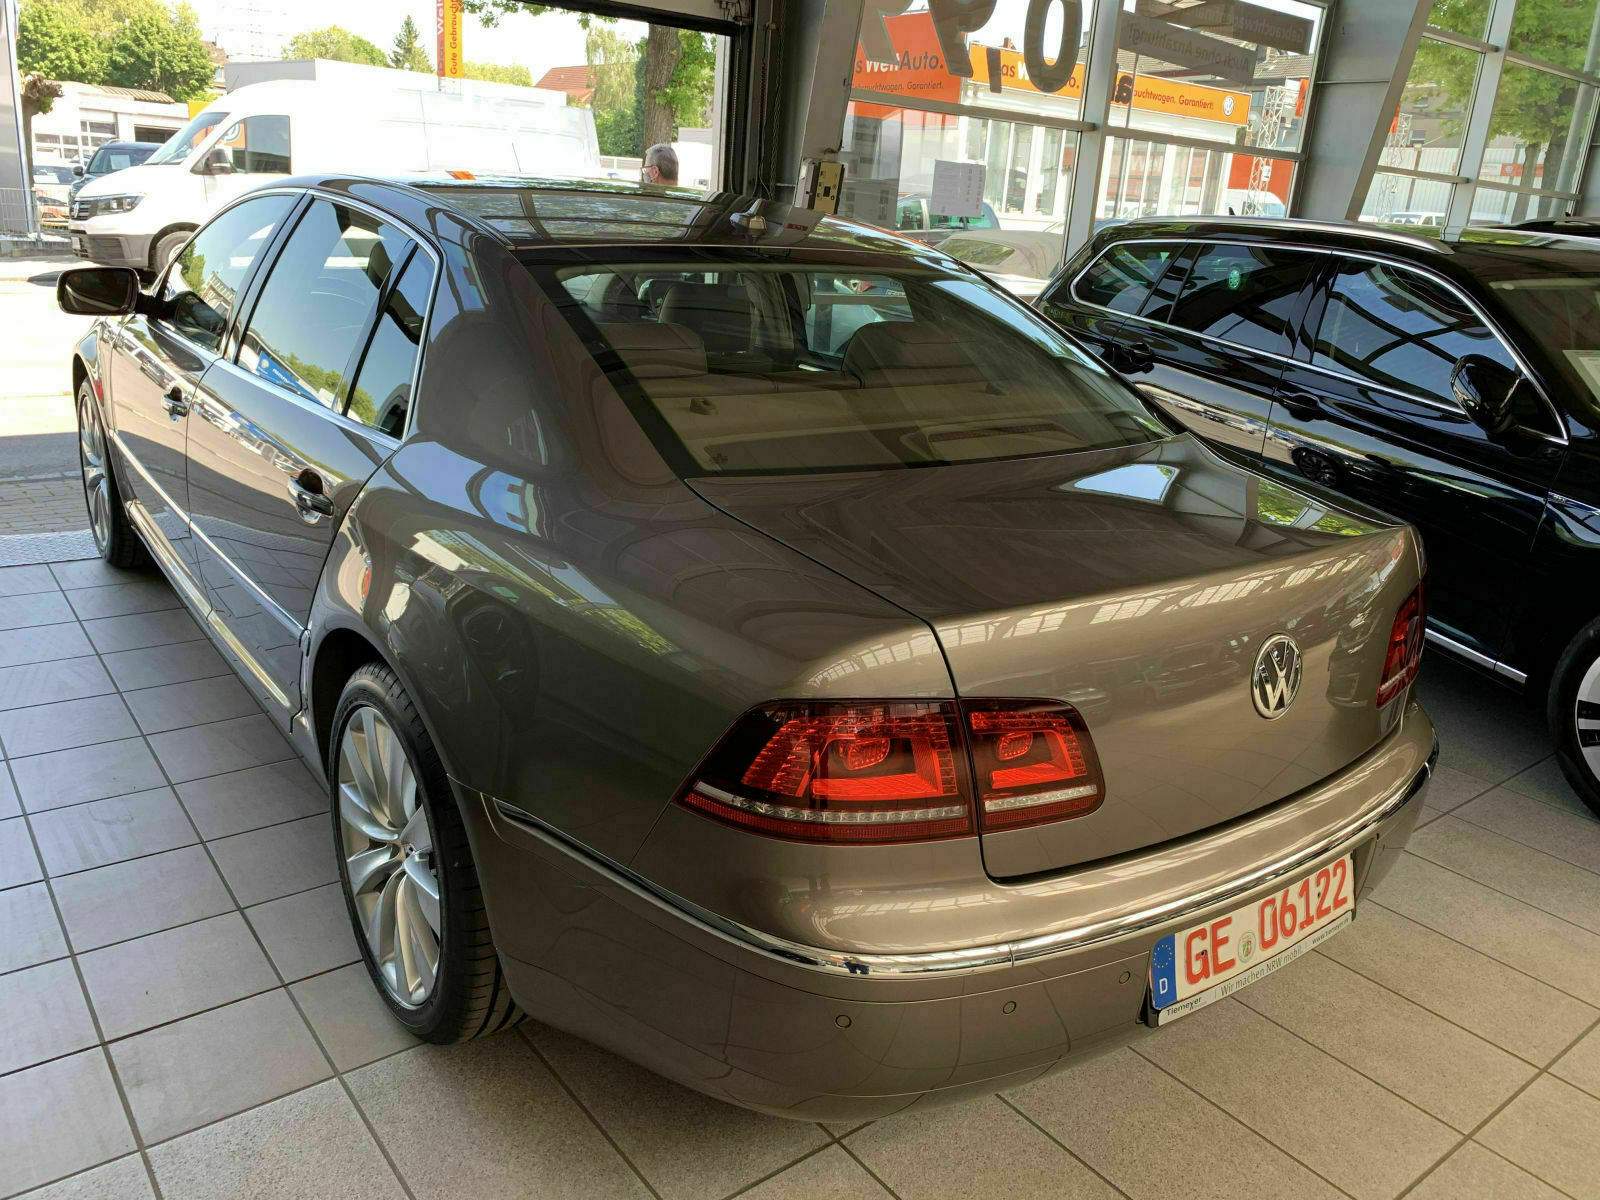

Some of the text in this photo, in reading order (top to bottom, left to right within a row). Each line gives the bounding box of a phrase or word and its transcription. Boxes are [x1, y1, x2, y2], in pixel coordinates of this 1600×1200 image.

[1185, 858, 1348, 985] GE 06122
[1160, 978, 1168, 995] D
[1166, 996, 1202, 1016] Tiemeyer
[1220, 983, 1234, 997] Wir
[1235, 970, 1265, 990] machen
[1265, 960, 1283, 974] NRW
